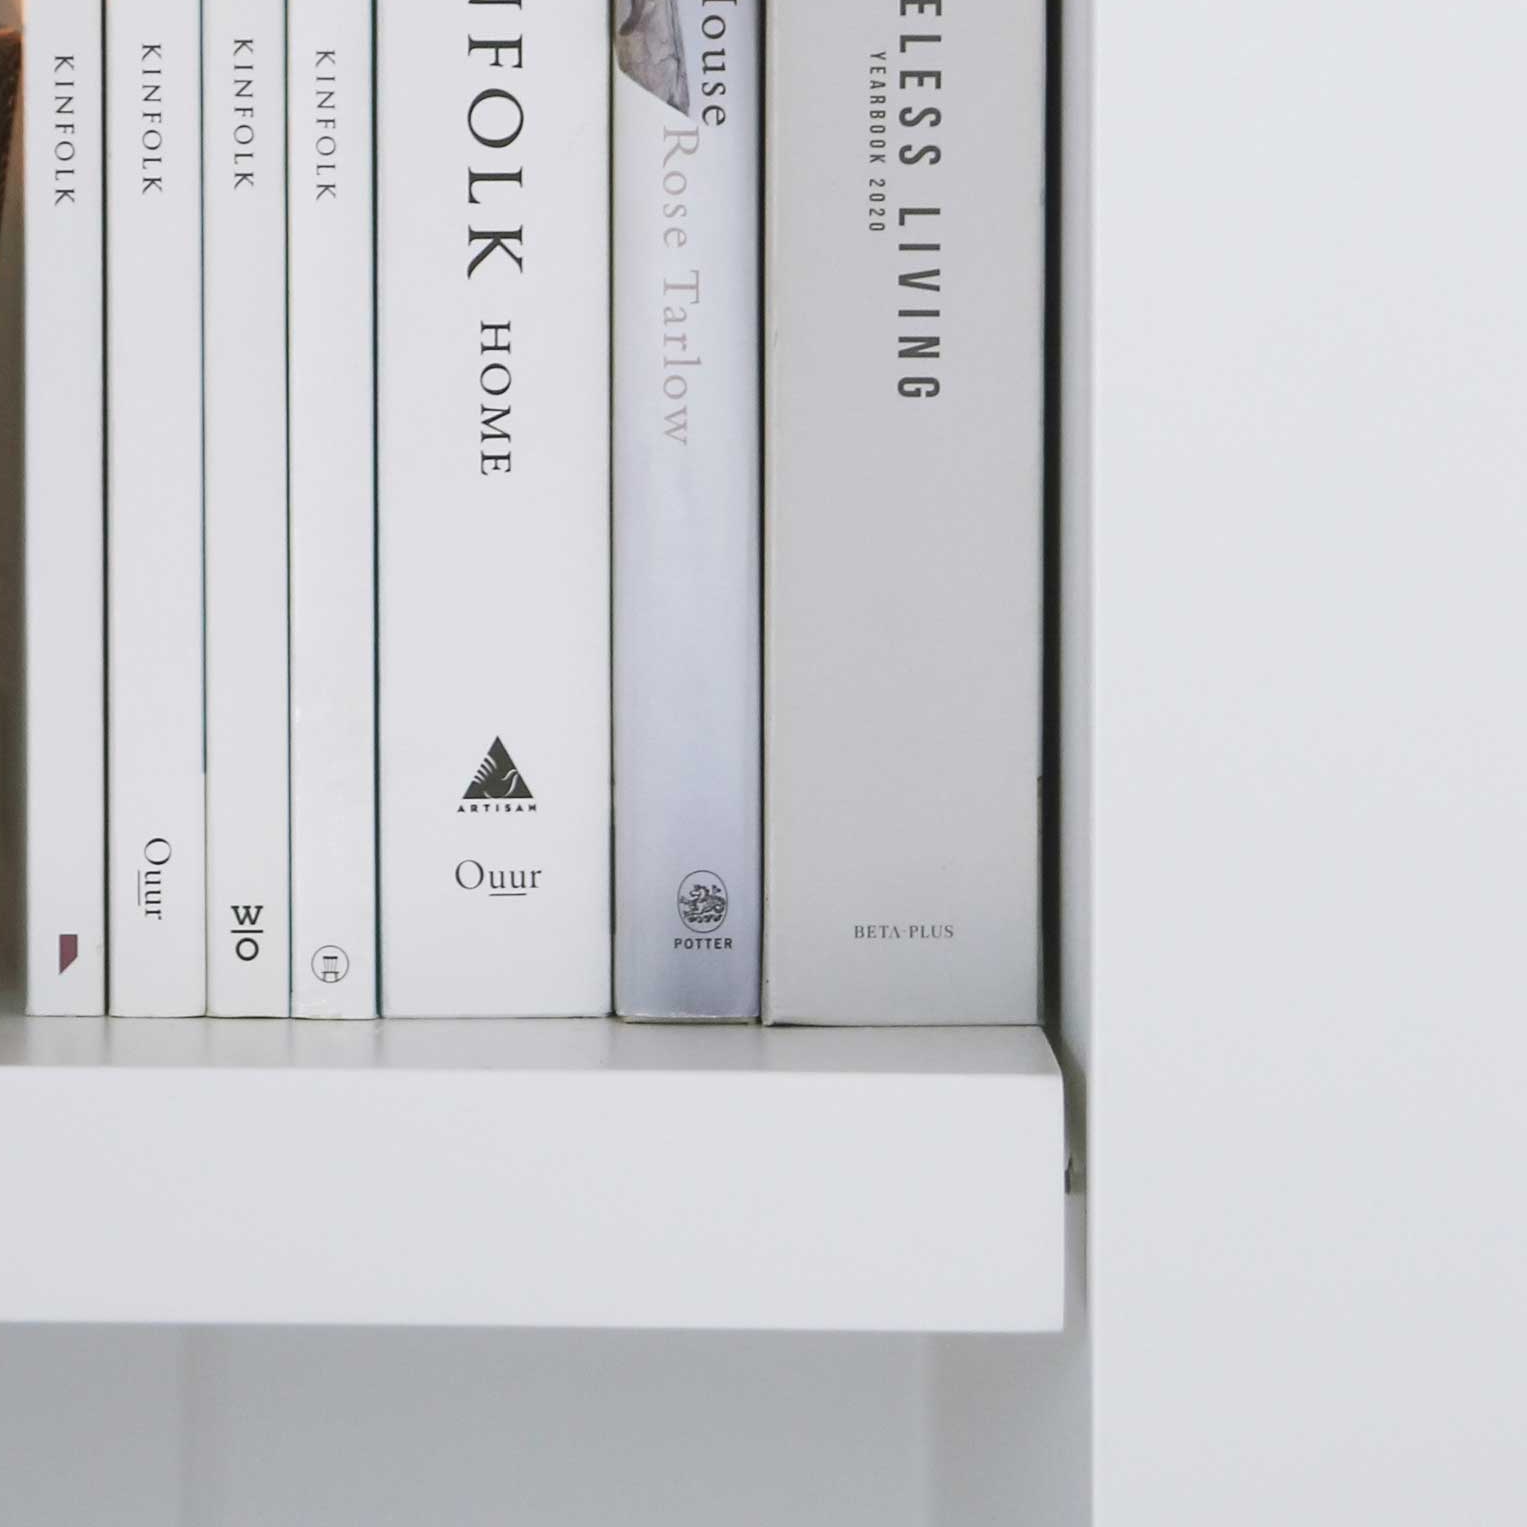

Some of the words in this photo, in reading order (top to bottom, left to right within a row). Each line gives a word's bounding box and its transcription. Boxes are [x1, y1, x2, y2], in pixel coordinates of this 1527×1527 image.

[54, 55, 75, 205] KINFOLK
[141, 44, 163, 193] KINFOLK
[233, 39, 254, 189] KINFOLK
[315, 50, 337, 200] KINFOLK
[869, 51, 887, 164] YEARBOOK
[663, 127, 700, 249] Rose
[868, 178, 886, 232] 2020
[662, 269, 703, 446] Tarlow
[897, 207, 941, 398] LIVING
[480, 321, 512, 476] HOME
[454, 859, 542, 890] Ouur
[457, 803, 537, 813] ARTISAN
[144, 837, 170, 920] Ouur
[674, 937, 733, 950] POTTER
